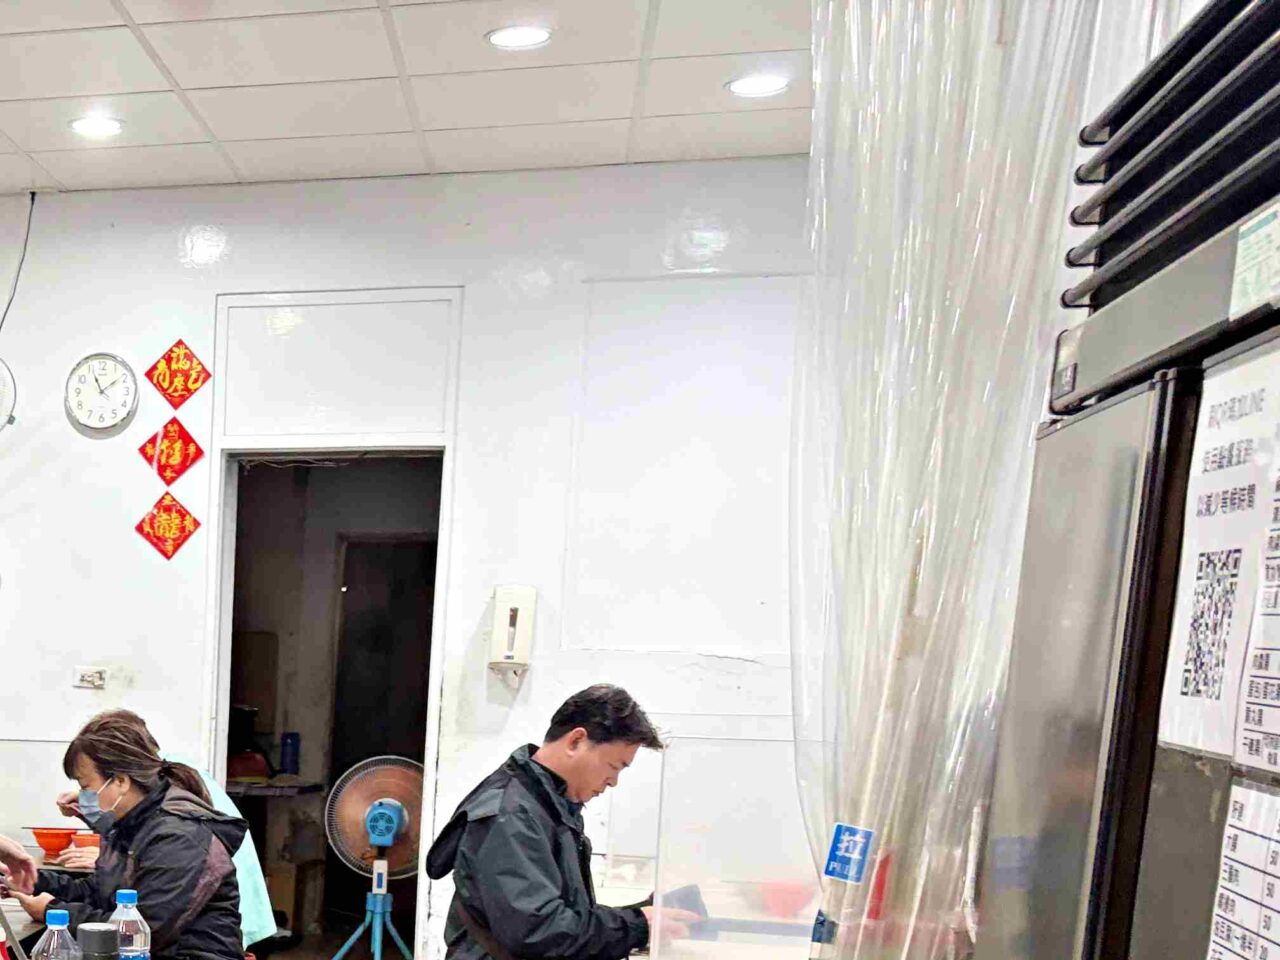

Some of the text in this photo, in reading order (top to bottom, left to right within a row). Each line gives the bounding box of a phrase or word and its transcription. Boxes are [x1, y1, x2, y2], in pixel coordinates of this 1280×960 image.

[97, 360, 107, 371] 12
[77, 374, 87, 385] 10
[122, 373, 129, 383] 2
[74, 387, 81, 397] 9
[123, 387, 130, 396] 3
[76, 400, 83, 410] 8
[121, 400, 127, 408] 4
[87, 410, 94, 420] 7
[98, 413, 105, 423] 6
[111, 409, 117, 419] 5
[836, 831, 866, 858] 拉
